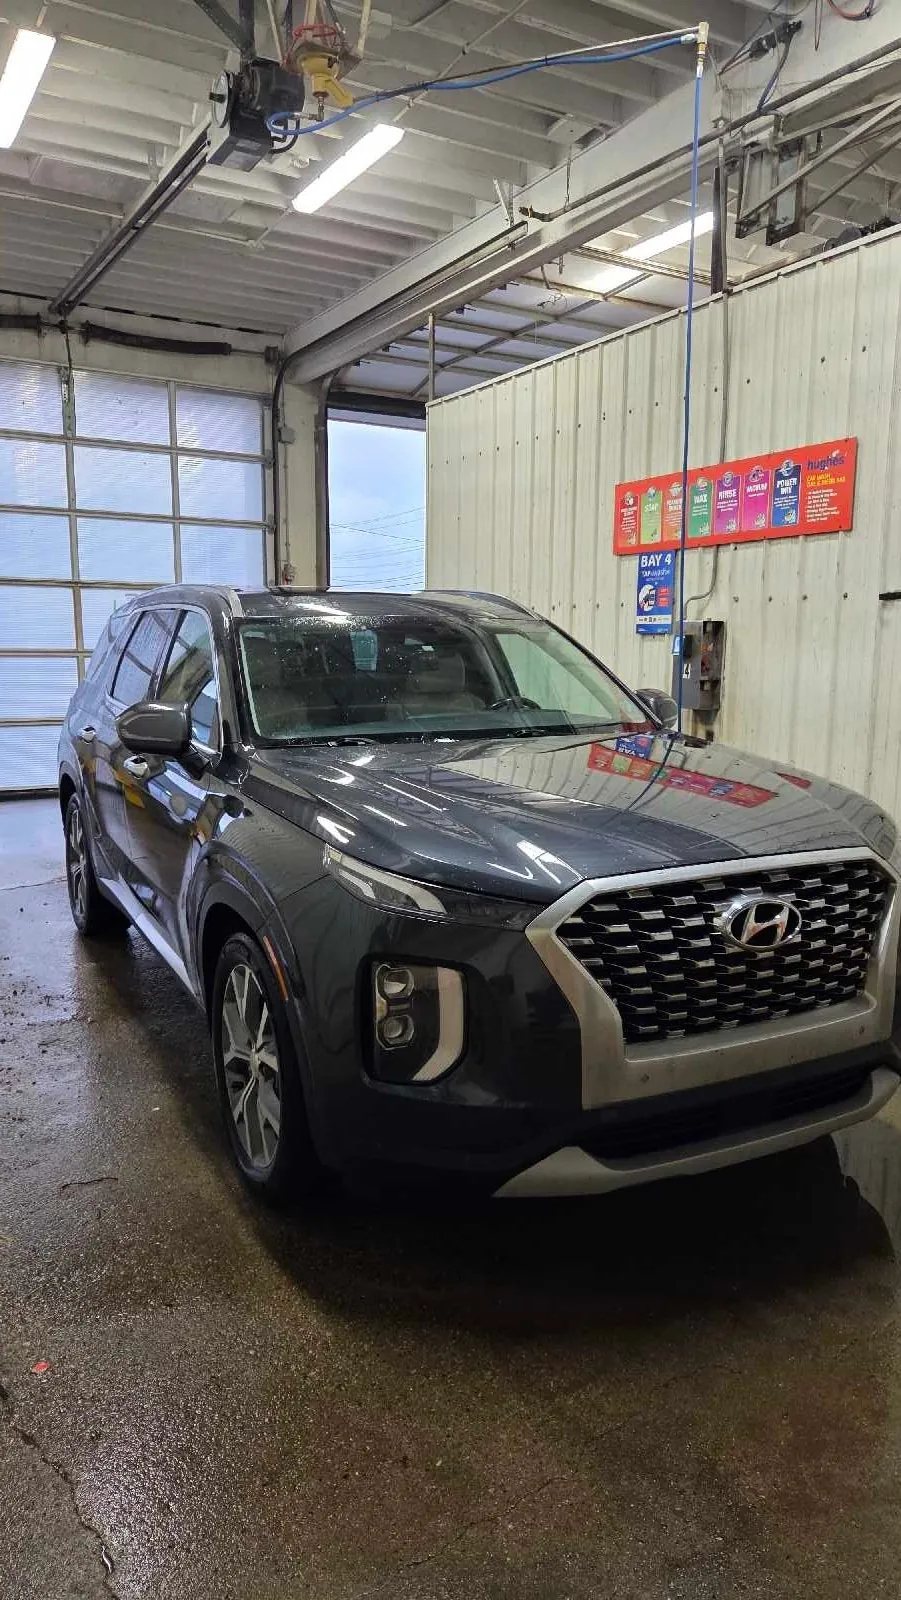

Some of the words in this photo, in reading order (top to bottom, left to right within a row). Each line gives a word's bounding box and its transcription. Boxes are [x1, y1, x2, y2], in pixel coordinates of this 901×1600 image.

[807, 455, 845, 471] hughes
[777, 477, 797, 488] POWER
[694, 494, 708, 504] WAX
[718, 489, 737, 500] RINSE
[644, 503, 659, 512] SOAP
[641, 553, 663, 568] BAY
[664, 553, 672, 565] 4
[684, 664, 690, 678] 4
